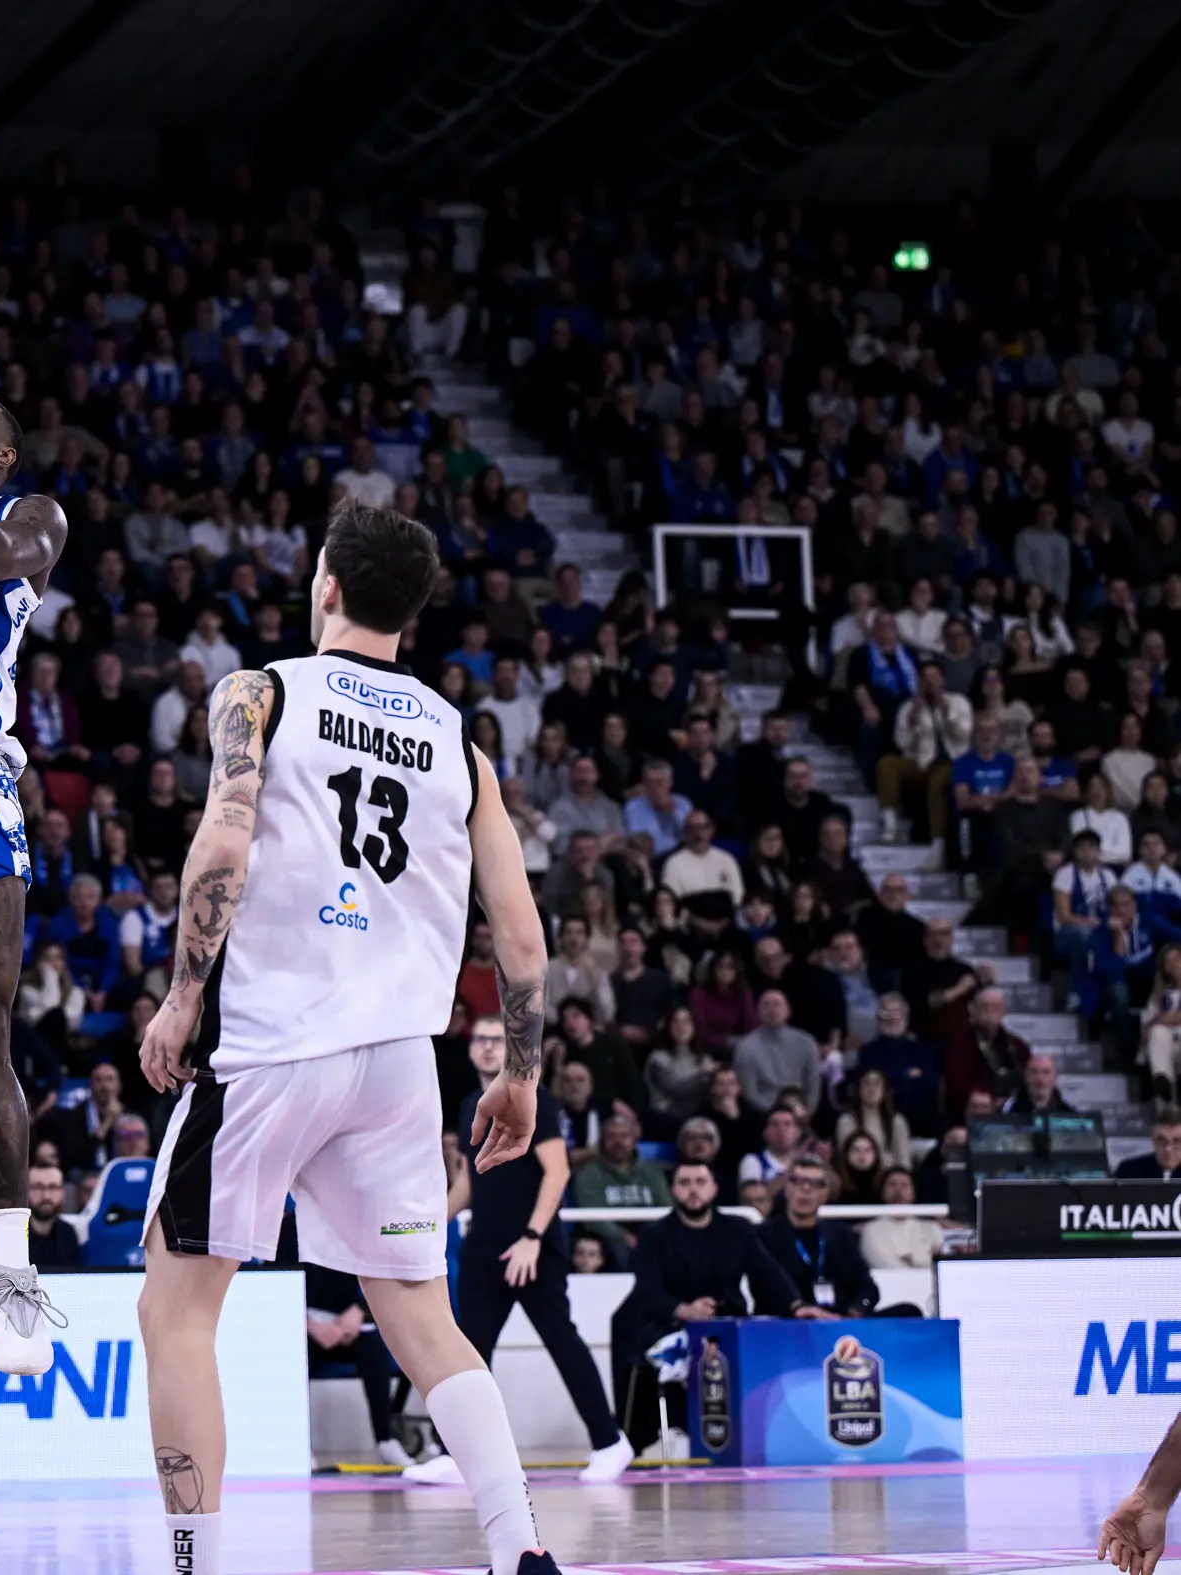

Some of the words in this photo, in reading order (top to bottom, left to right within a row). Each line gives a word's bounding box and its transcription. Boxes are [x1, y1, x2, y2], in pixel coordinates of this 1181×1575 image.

[319, 709, 433, 772] BALDASSO
[327, 765, 409, 884] 13
[319, 905, 369, 931] Costa
[1060, 1194, 1181, 1231] ITALIAN
[832, 1380, 876, 1401] LBA
